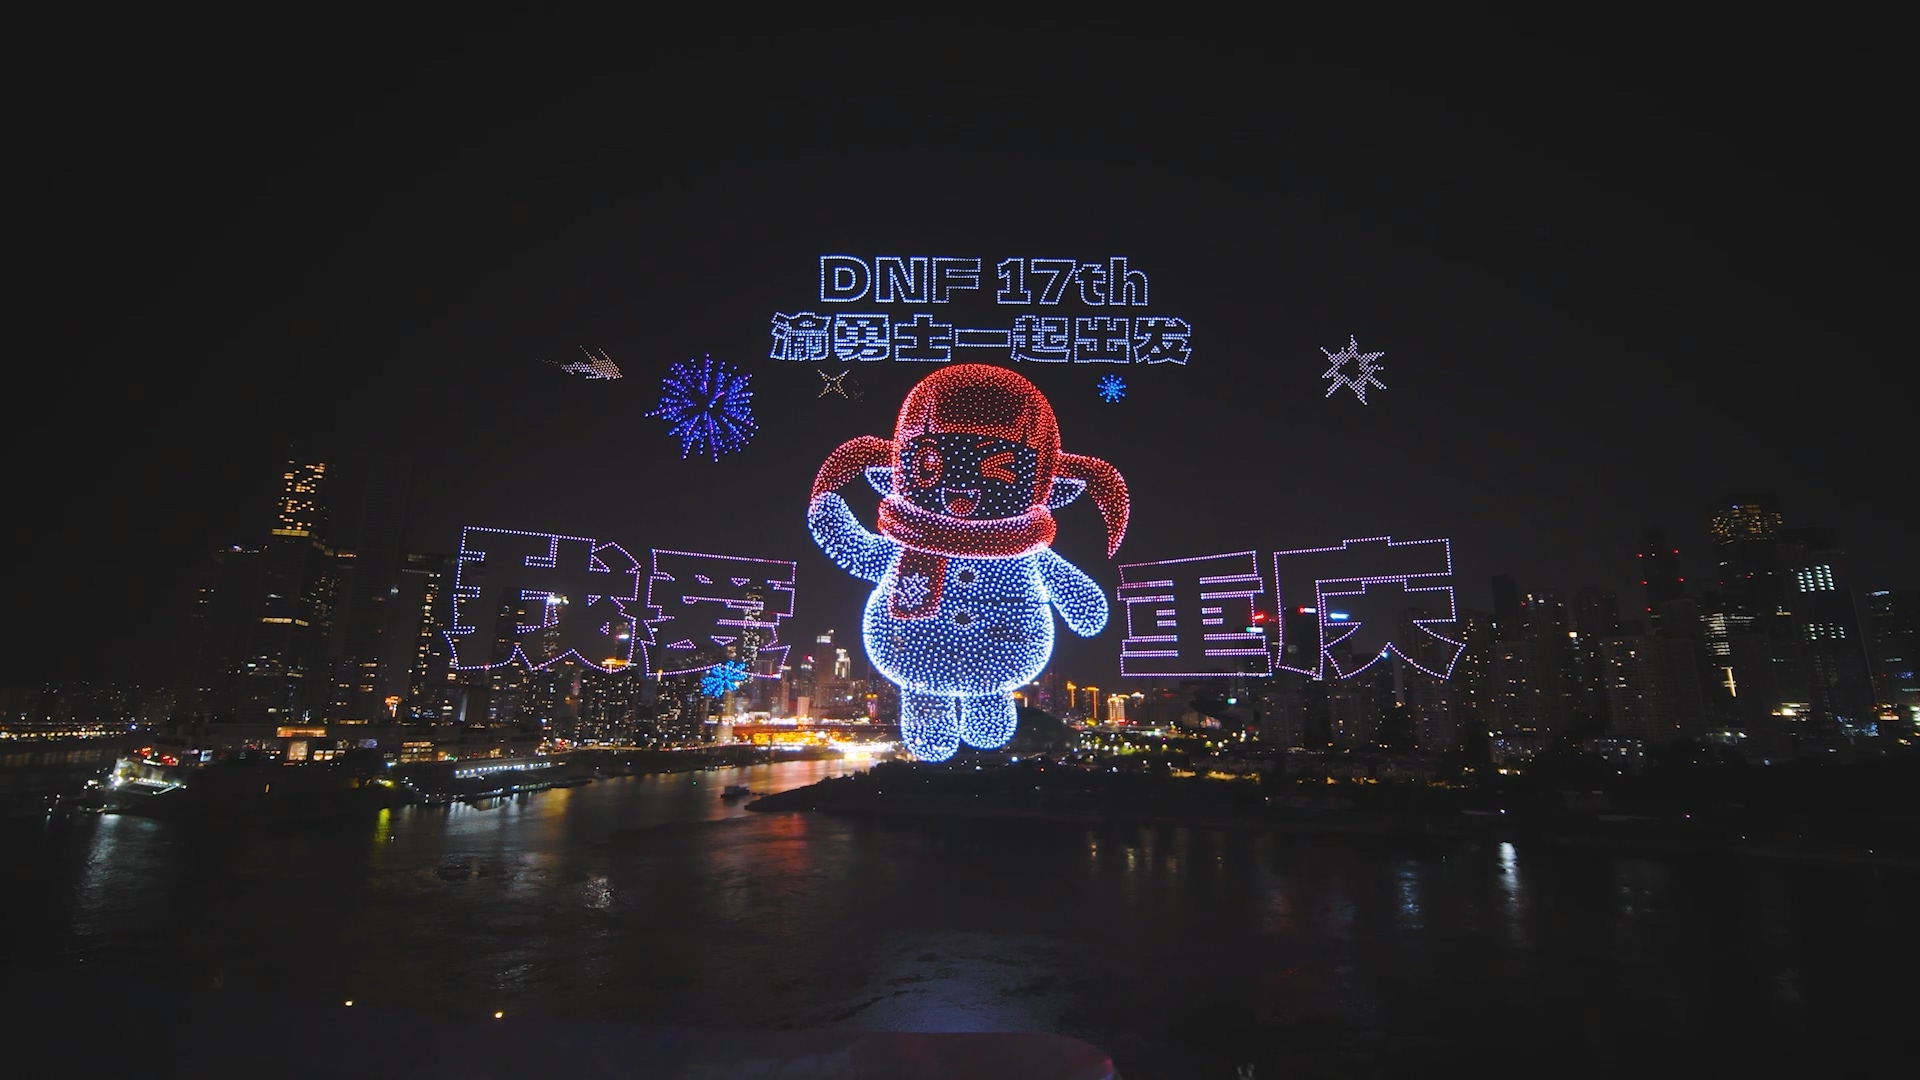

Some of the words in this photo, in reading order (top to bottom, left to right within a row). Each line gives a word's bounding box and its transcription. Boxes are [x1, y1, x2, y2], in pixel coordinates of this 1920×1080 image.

[819, 255, 981, 304] DNF
[996, 256, 1150, 306] 17th
[769, 311, 1193, 365] 渝勇士一起出发
[443, 525, 797, 680] 我爱
[1115, 534, 1466, 681] 重庆
